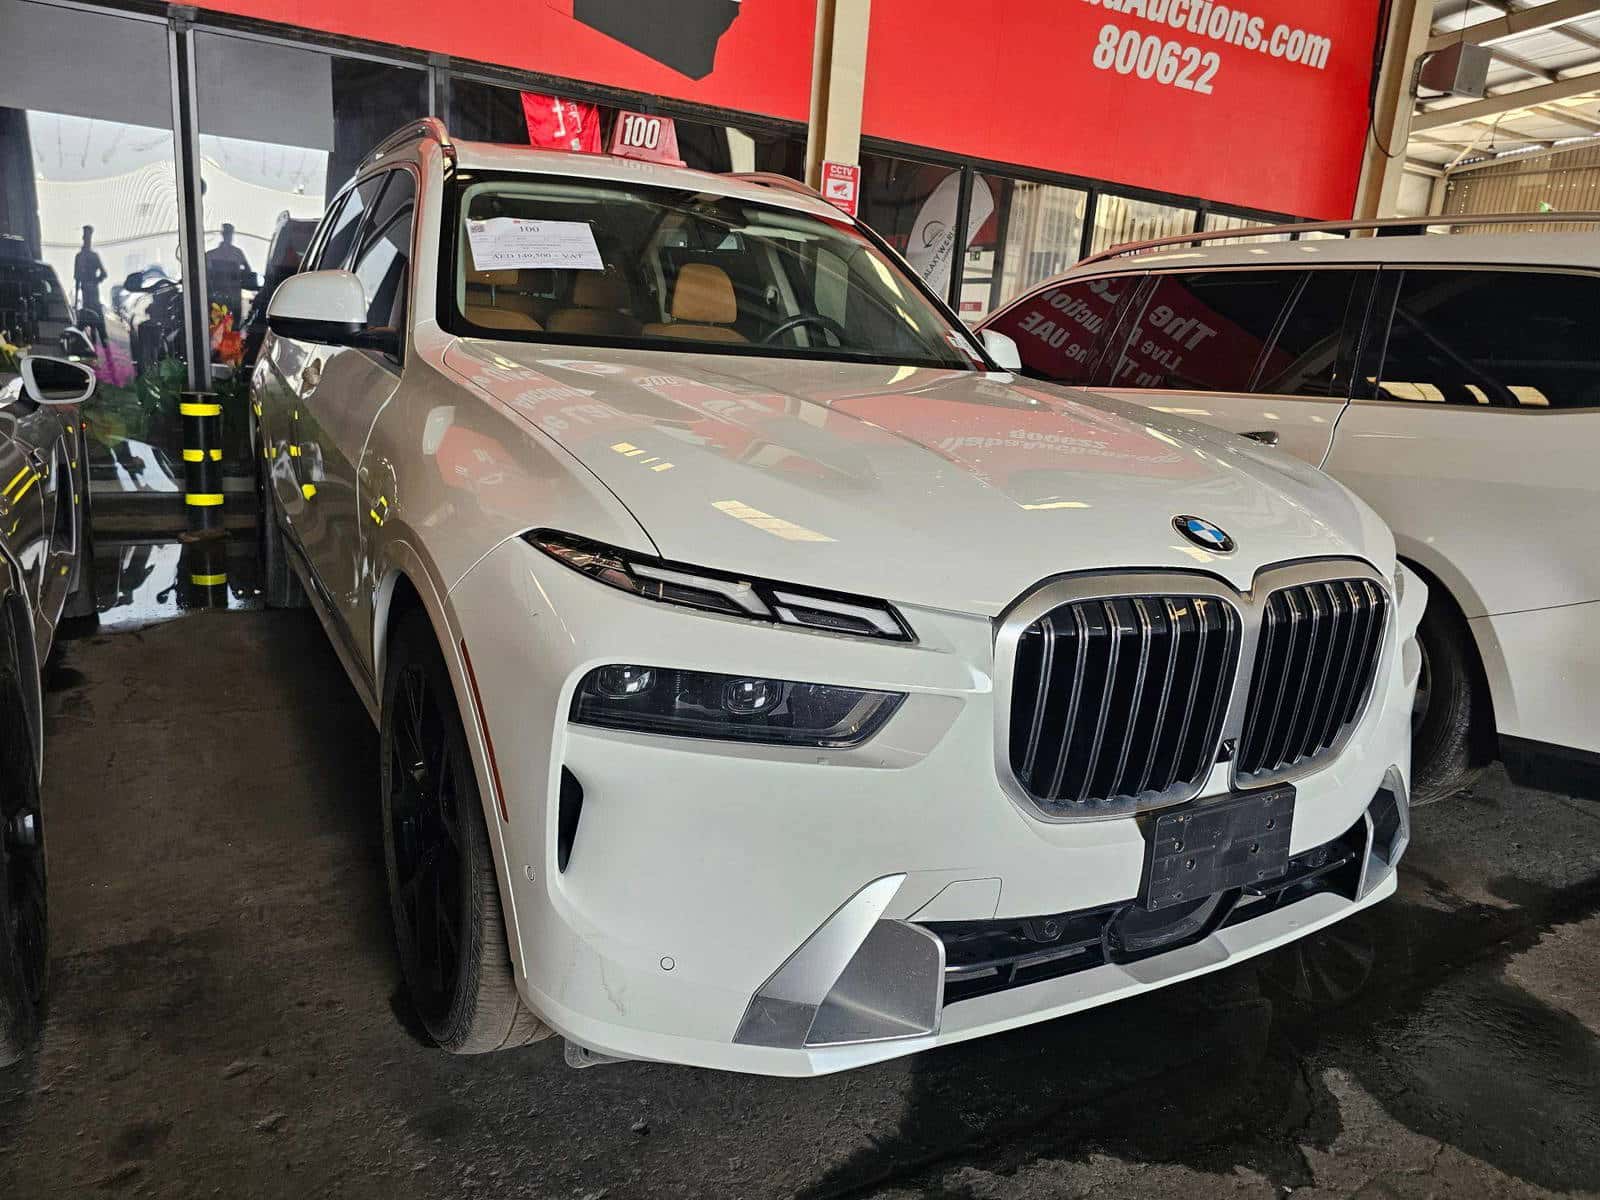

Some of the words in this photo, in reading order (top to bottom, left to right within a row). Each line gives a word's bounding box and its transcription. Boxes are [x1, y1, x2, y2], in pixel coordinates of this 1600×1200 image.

[1092, 24, 1221, 95] 800622
[624, 115, 661, 150] 100
[830, 165, 853, 177] CCTV
